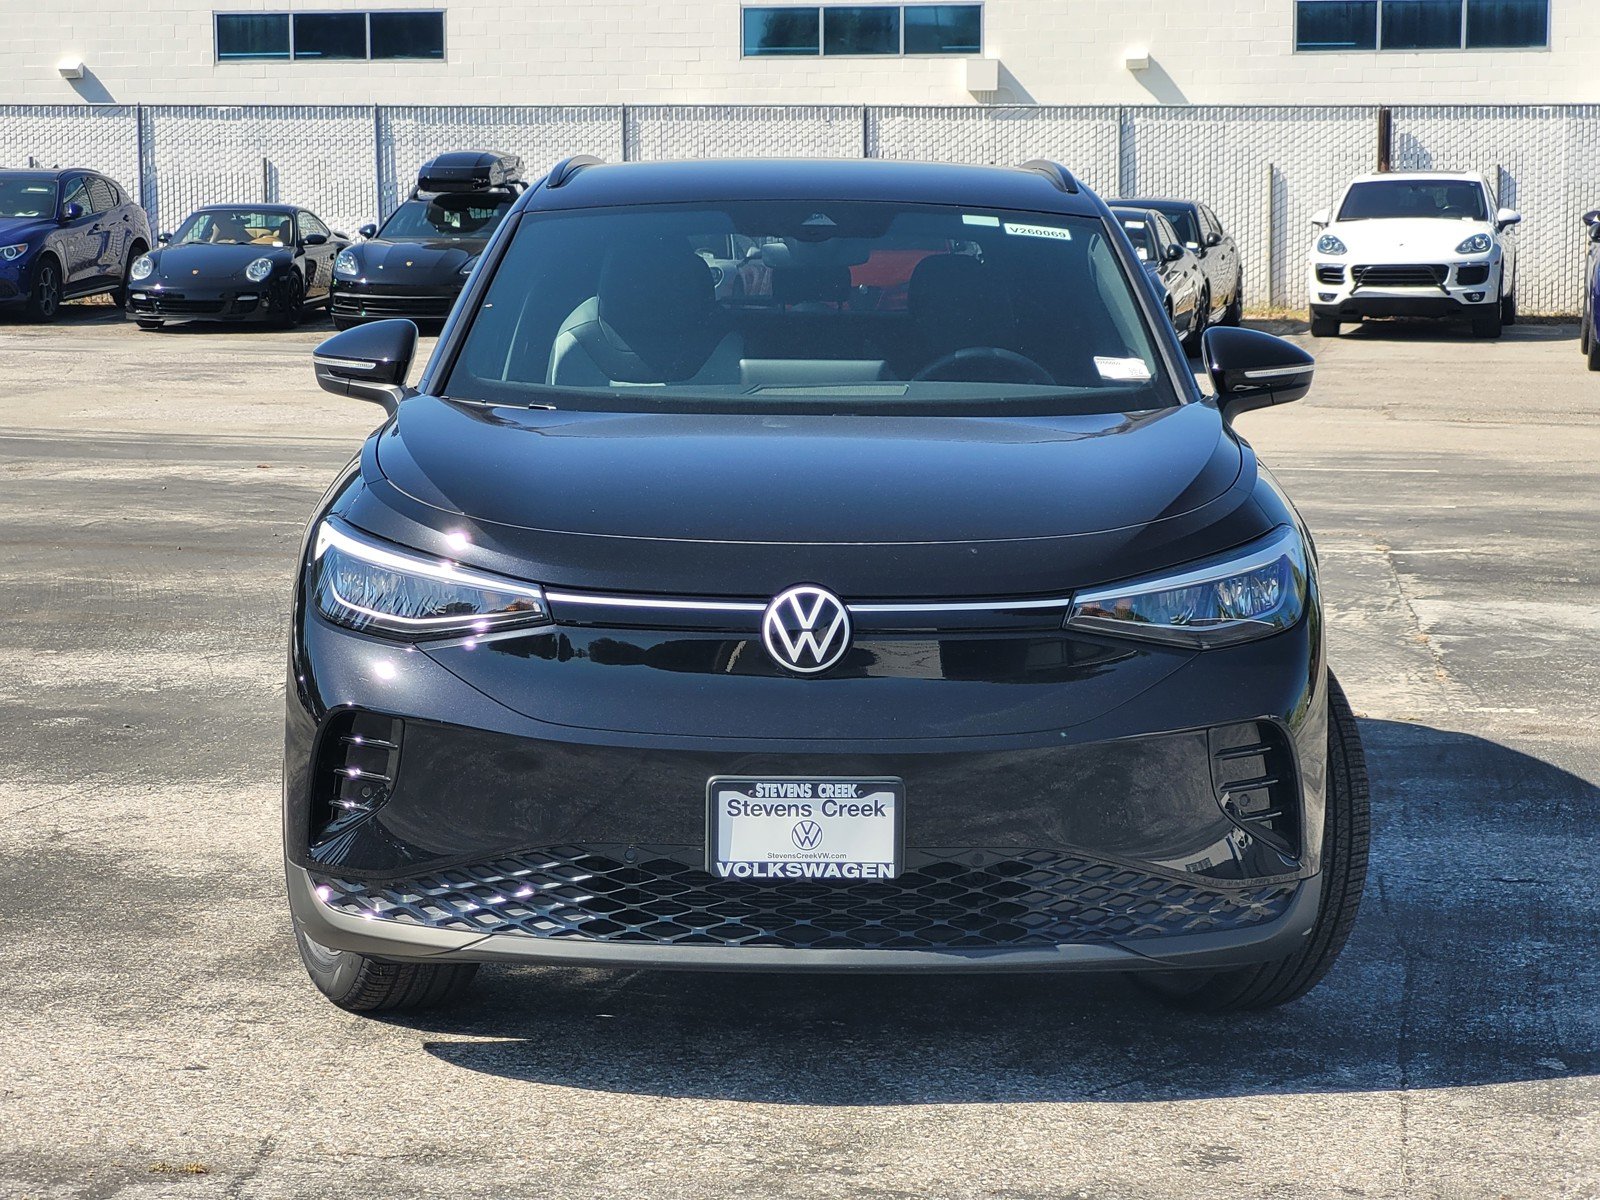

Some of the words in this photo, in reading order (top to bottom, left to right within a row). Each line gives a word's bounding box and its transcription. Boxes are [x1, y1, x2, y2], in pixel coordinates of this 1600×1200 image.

[1009, 226, 1066, 238] V260069
[765, 587, 850, 672] VW
[755, 783, 813, 798] STEVENS
[818, 783, 858, 798] CREEK
[726, 799, 813, 818] Stevens
[821, 799, 887, 818] Creek
[792, 820, 823, 851] VW
[716, 862, 895, 879] VOLKSWAGEN
